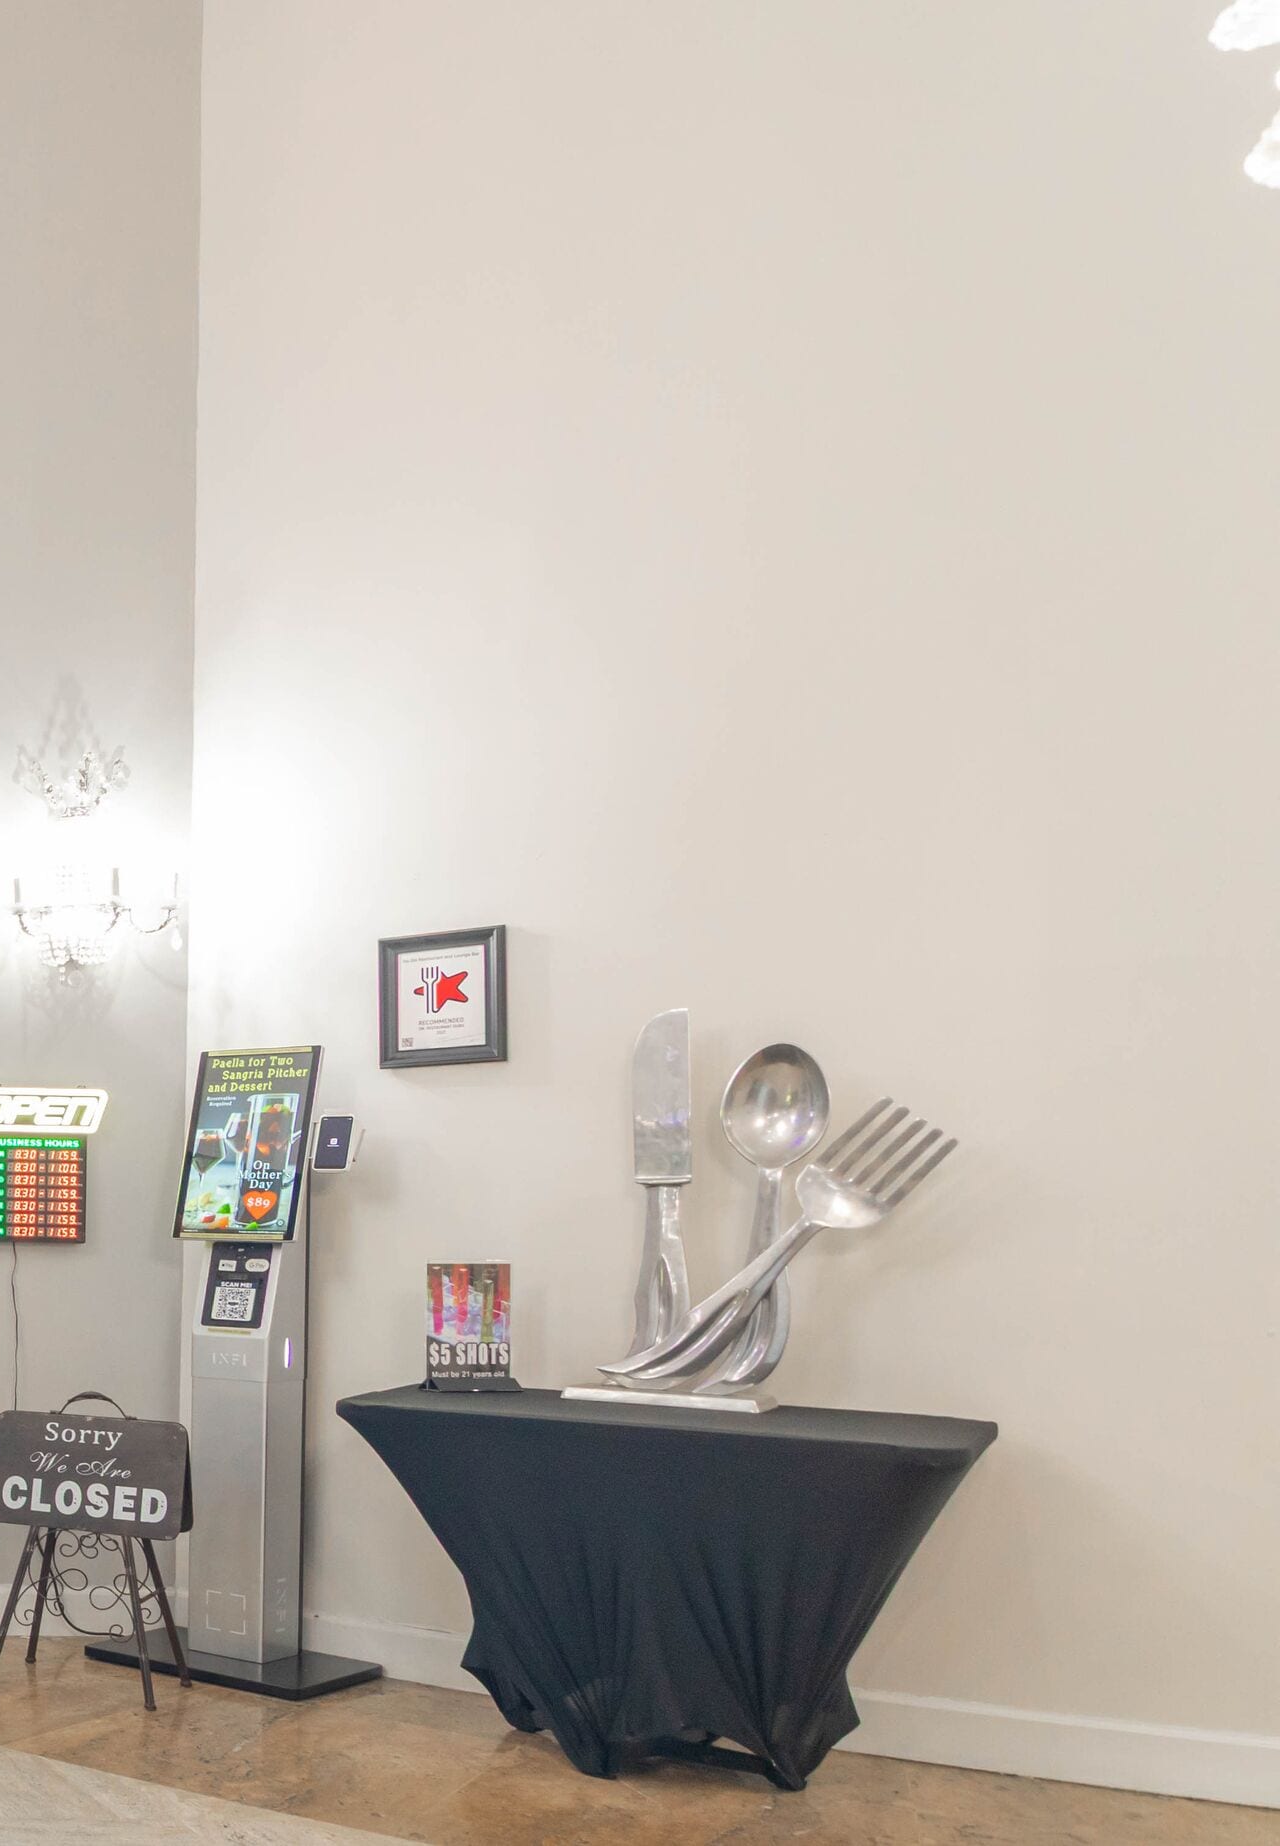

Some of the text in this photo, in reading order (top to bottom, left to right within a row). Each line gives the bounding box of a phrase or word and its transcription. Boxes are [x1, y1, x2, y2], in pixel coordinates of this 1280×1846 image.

[211, 1056, 294, 1069] Paella for Two
[222, 1067, 309, 1081] Sangria Pitcher
[207, 1081, 273, 1093] and Dessert
[44, 1138, 80, 1148] HOURS
[253, 1160, 271, 1170] On
[249, 1179, 274, 1191] Day
[247, 1197, 271, 1208] $89
[429, 1342, 509, 1367] $5 SHOTS
[44, 1421, 123, 1451] Sorry
[29, 1451, 133, 1479] We Are
[1, 1475, 169, 1524] CLOSED
